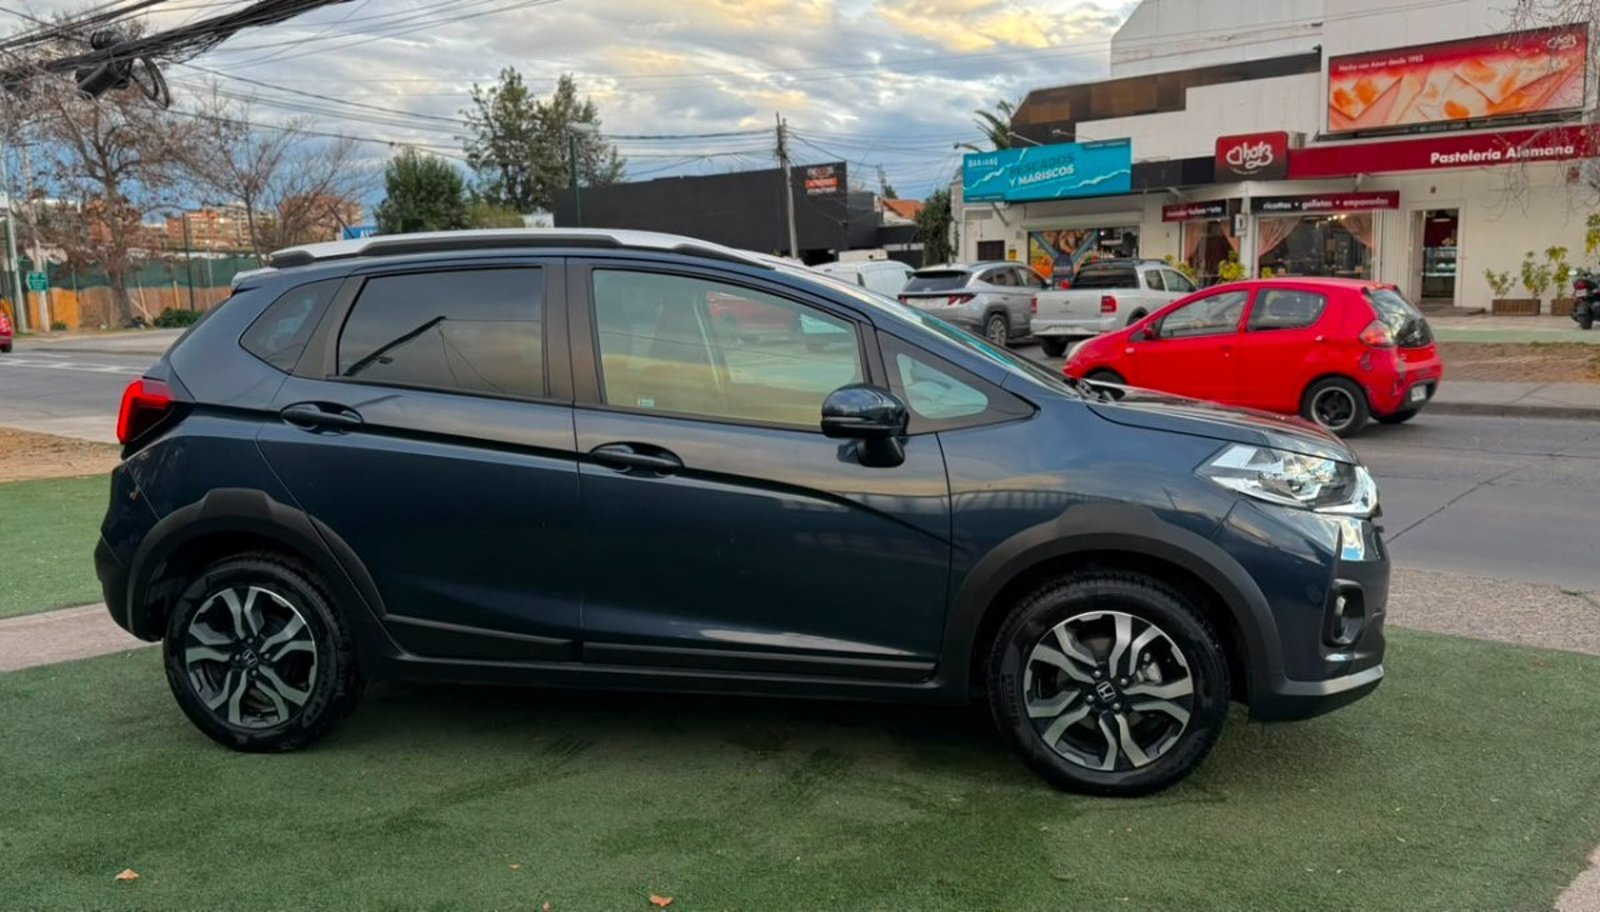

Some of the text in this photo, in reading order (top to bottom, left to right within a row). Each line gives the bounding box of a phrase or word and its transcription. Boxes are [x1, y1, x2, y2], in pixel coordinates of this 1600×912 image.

[1430, 144, 1574, 165] Pastelería Alemana
[1009, 164, 1074, 187] Y MARISCOS
